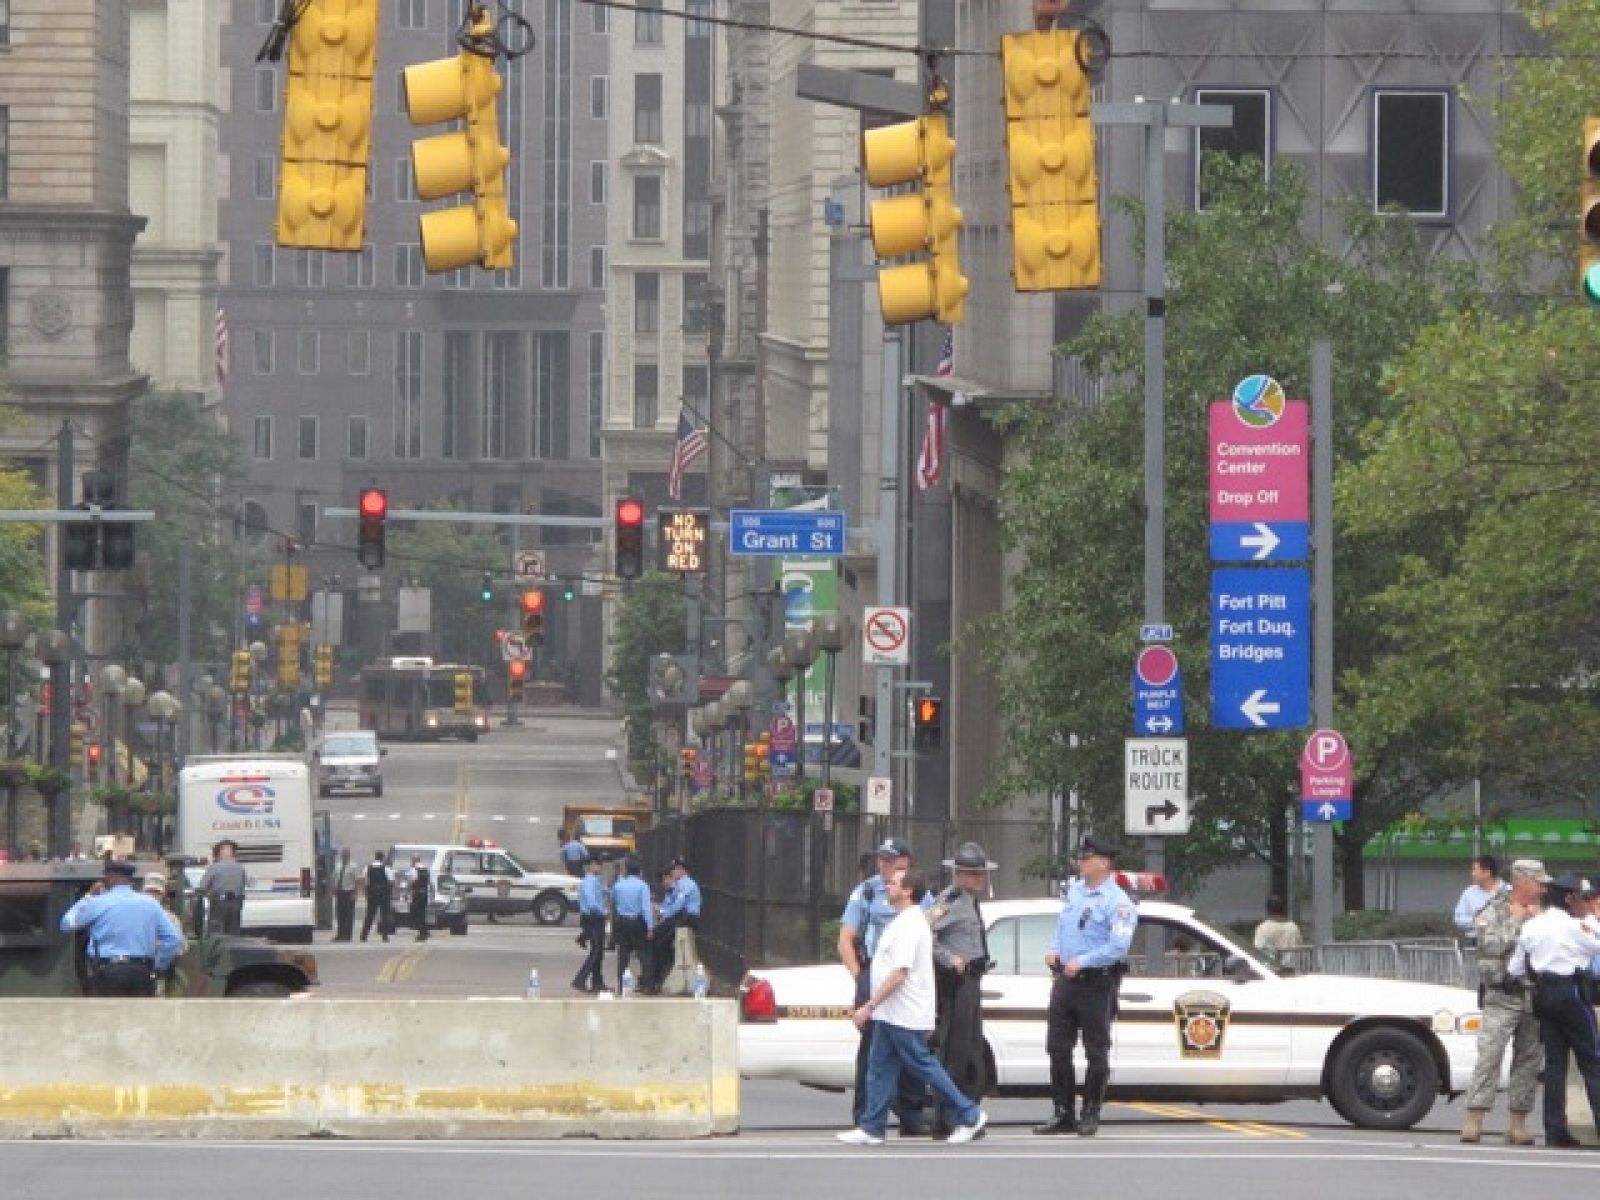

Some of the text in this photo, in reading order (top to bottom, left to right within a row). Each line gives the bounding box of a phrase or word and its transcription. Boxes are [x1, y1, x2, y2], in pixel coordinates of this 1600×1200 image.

[1216, 443, 1301, 456] Convention
[1216, 460, 1266, 475] Center
[1216, 489, 1280, 507] Drop Off
[673, 513, 696, 526] NO
[663, 526, 705, 541] TURN
[743, 530, 833, 551] Grant St
[672, 540, 696, 555] ON
[666, 554, 700, 569] RED
[1218, 594, 1287, 610] Fort Pitt
[1218, 619, 1296, 638] Fort Duq.
[1218, 644, 1284, 663] Bridges
[1138, 690, 1177, 700] PURPLE
[1146, 700, 1171, 711] BELT
[1130, 749, 1184, 766] TRUCK
[1316, 736, 1337, 764] P
[1129, 772, 1185, 791] ROUTE
[1308, 774, 1346, 788] Parking
